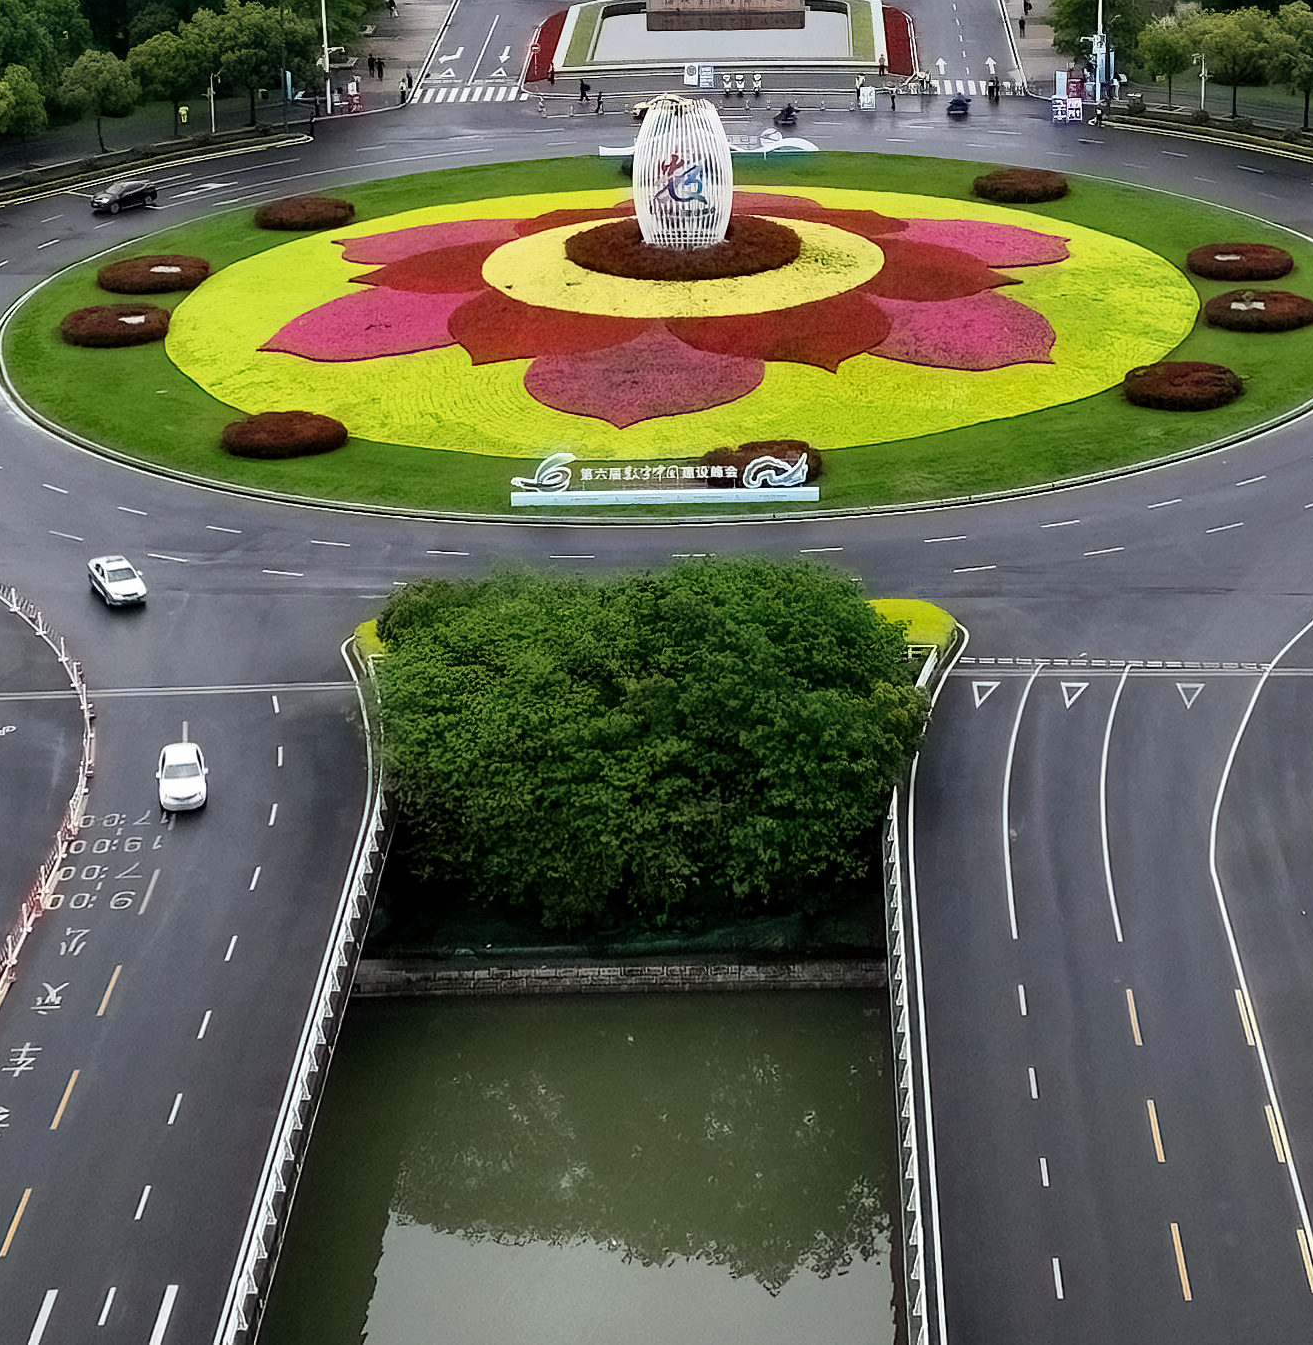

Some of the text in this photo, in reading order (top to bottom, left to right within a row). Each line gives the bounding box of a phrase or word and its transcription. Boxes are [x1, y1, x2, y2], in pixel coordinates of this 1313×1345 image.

[580, 464, 738, 483] 第六届数字中国建设峰会
[69, 836, 163, 854] 19:00
